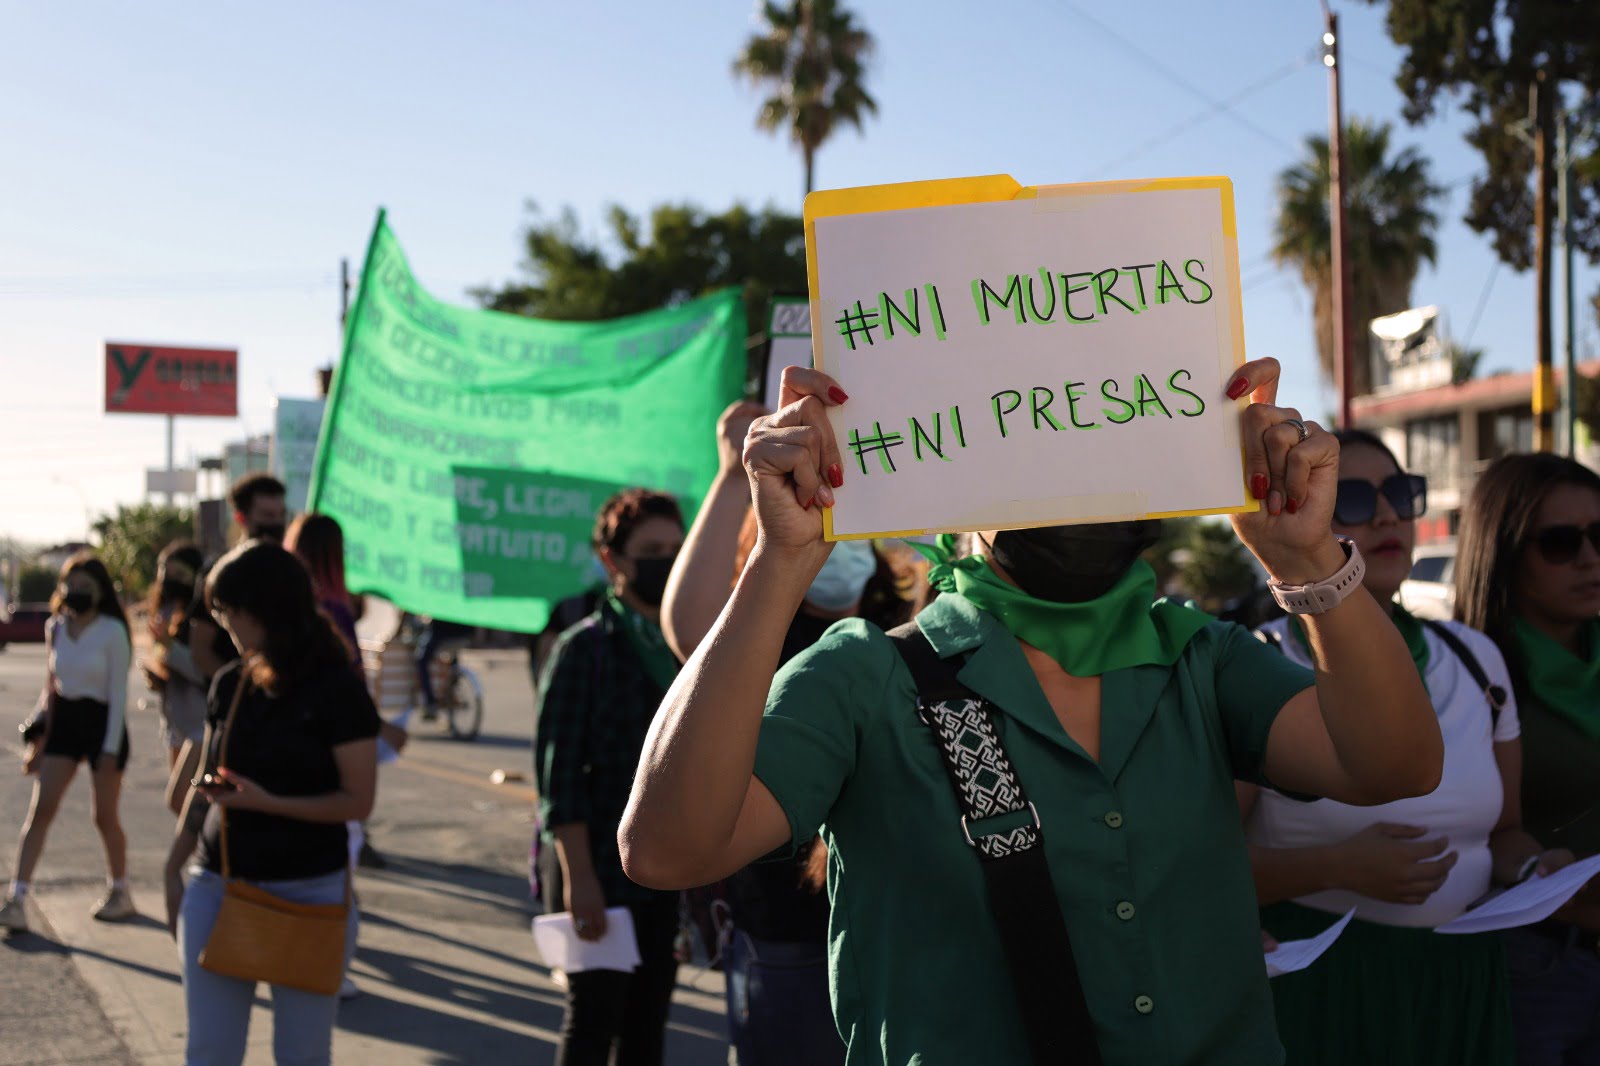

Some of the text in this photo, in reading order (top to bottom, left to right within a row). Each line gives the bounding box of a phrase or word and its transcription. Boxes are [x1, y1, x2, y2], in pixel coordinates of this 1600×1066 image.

[835, 283, 947, 350] #NI
[970, 258, 1213, 325] MUERTAS
[847, 369, 1206, 475] #NI PRESAS
